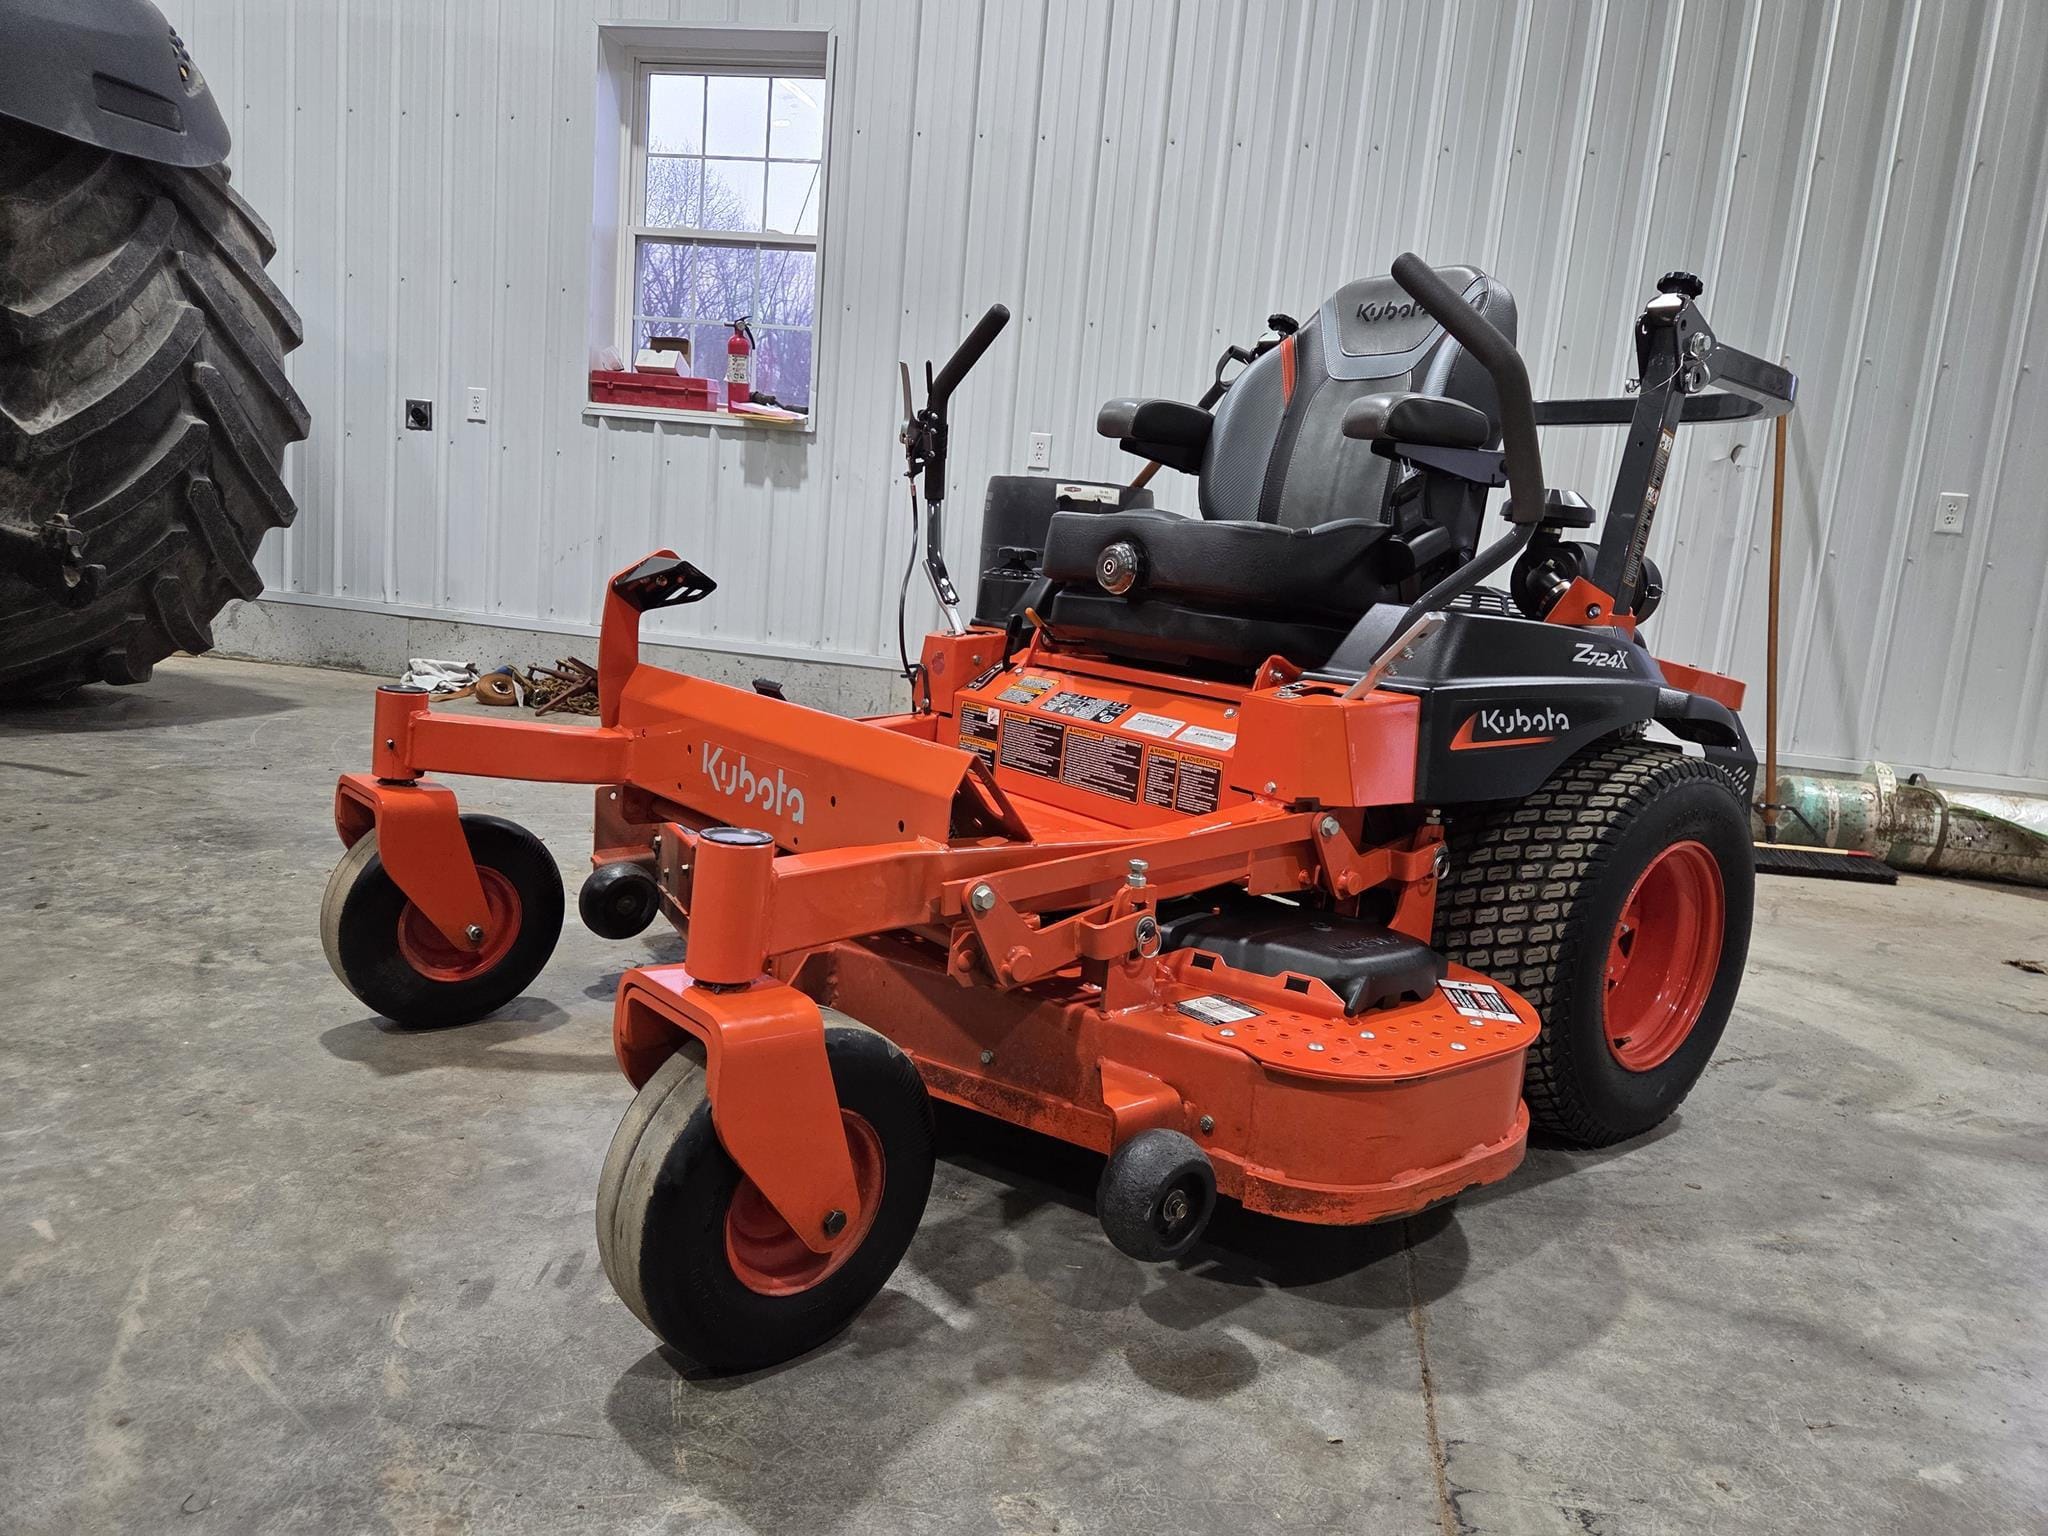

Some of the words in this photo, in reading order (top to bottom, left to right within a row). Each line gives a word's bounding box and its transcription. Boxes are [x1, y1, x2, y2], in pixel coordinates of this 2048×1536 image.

[1572, 643, 1629, 669] Z724X
[1481, 706, 1570, 734] Kubota
[1154, 748, 1176, 758] WARNING
[1186, 756, 1222, 768] ADVERTENCIA
[702, 742, 805, 825] Kubota
